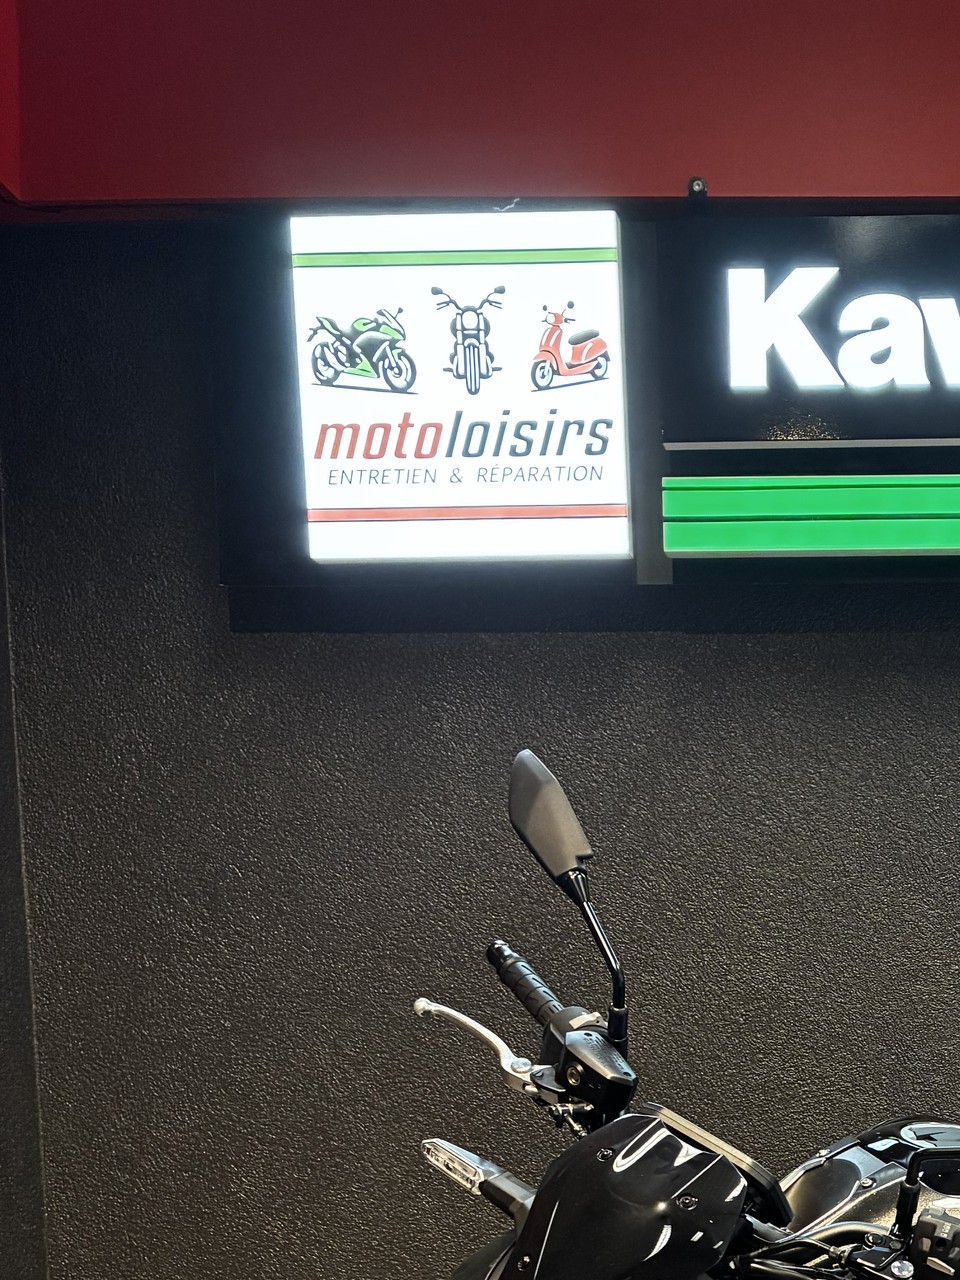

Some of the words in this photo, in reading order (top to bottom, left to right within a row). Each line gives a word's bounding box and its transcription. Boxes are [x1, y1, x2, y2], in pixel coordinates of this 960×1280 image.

[314, 409, 613, 459] motoloisirs
[328, 468, 437, 486] ENTRETIEN
[449, 467, 463, 484] &
[476, 463, 603, 483] RÉPARATION
